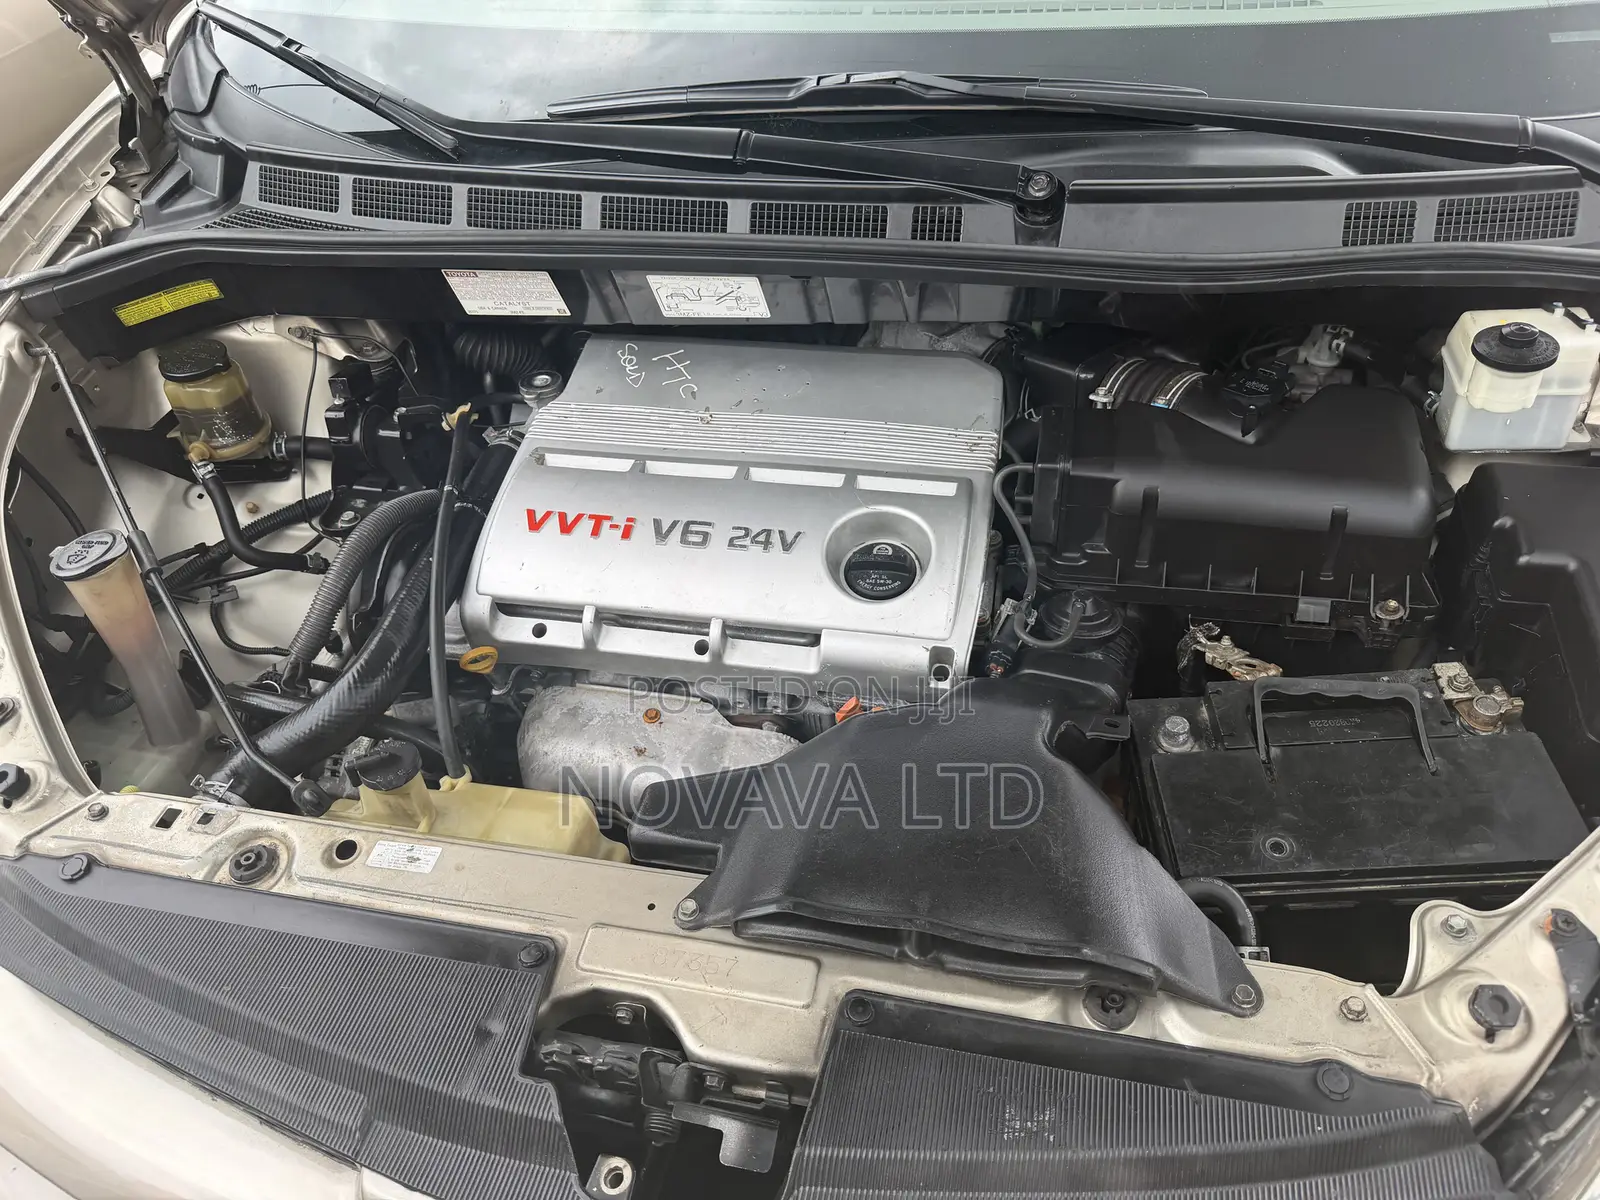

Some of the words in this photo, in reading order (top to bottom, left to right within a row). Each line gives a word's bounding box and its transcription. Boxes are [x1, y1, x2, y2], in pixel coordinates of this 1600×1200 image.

[525, 508, 637, 541] VVT-i
[652, 516, 716, 550] V6
[726, 525, 806, 555] 24V
[652, 945, 739, 978] 87357
